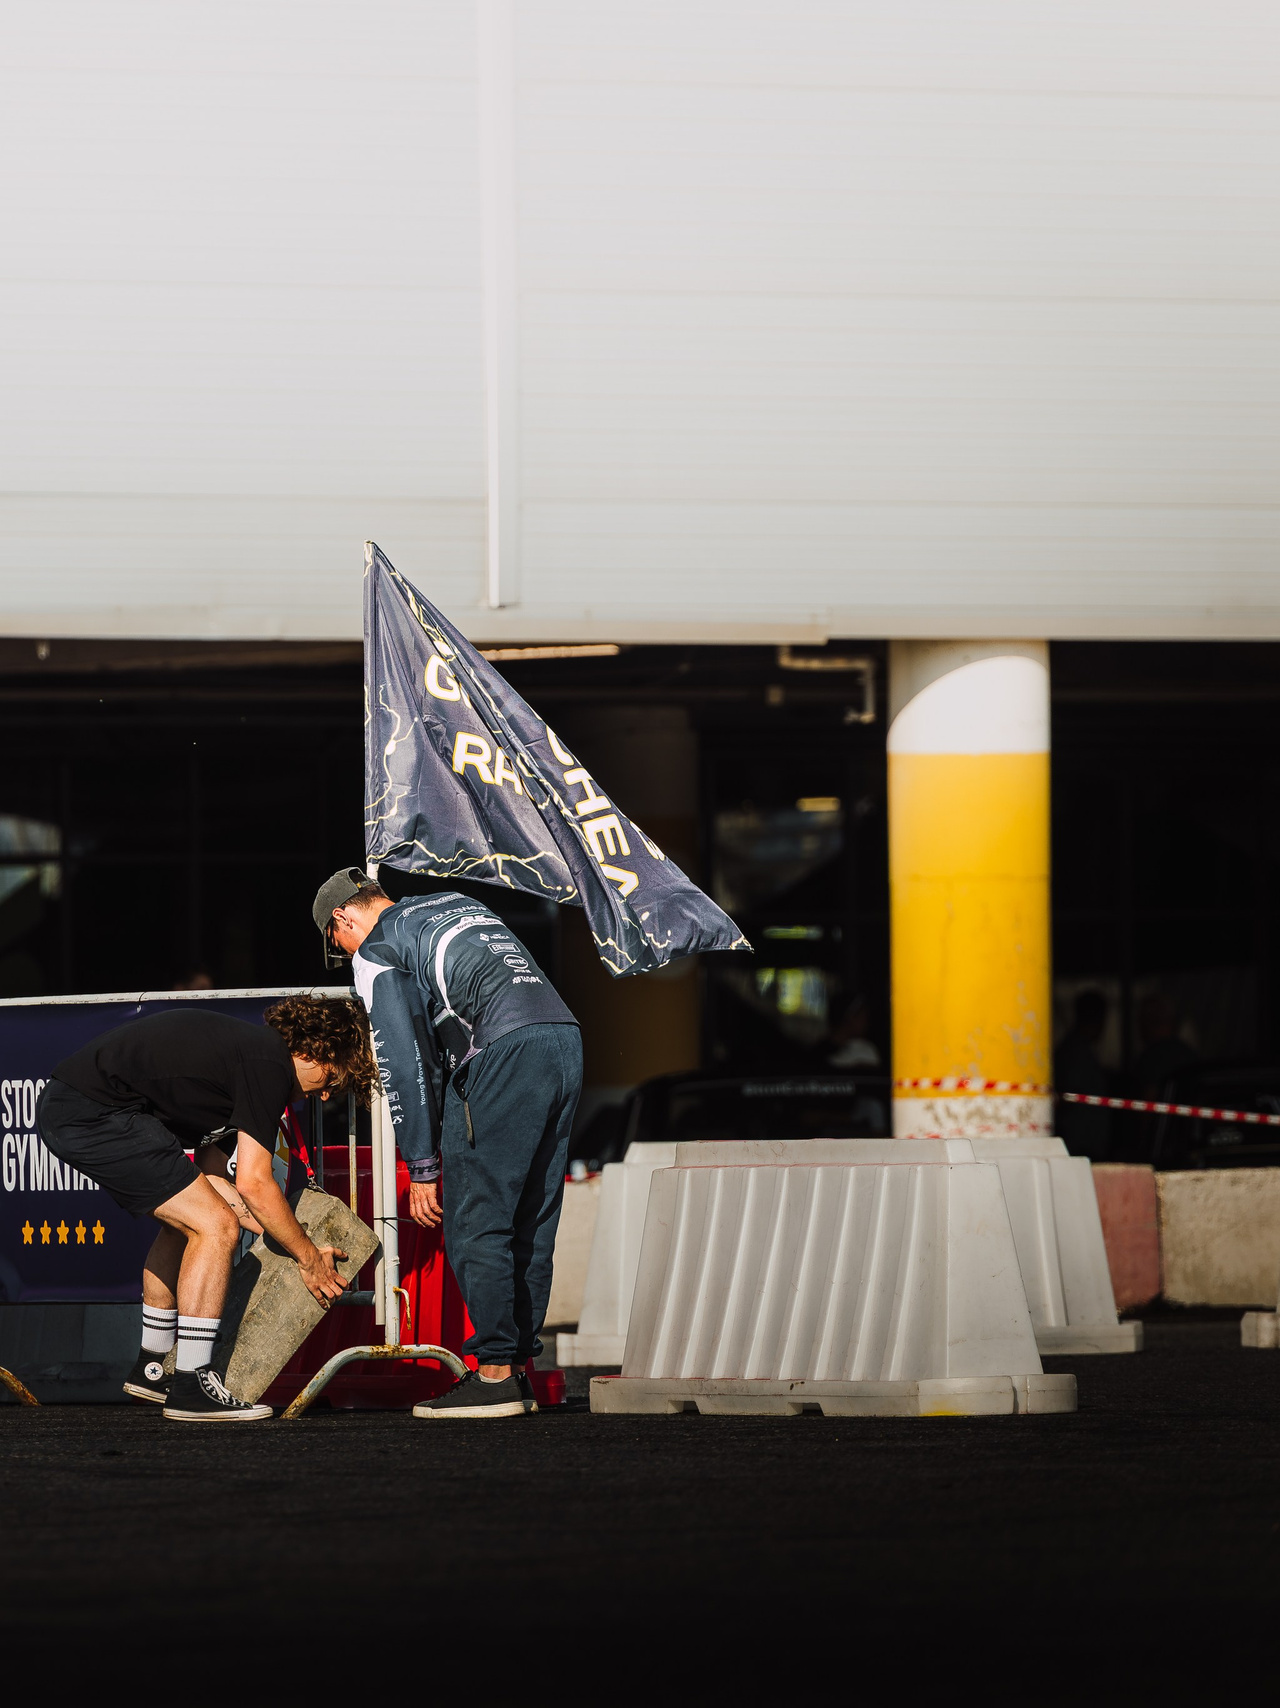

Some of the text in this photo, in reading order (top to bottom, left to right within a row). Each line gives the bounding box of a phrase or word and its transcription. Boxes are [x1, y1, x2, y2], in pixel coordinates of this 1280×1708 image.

[452, 731, 535, 801] RA
[413, 1040, 421, 1062] Team
[1, 1079, 50, 1129] STO
